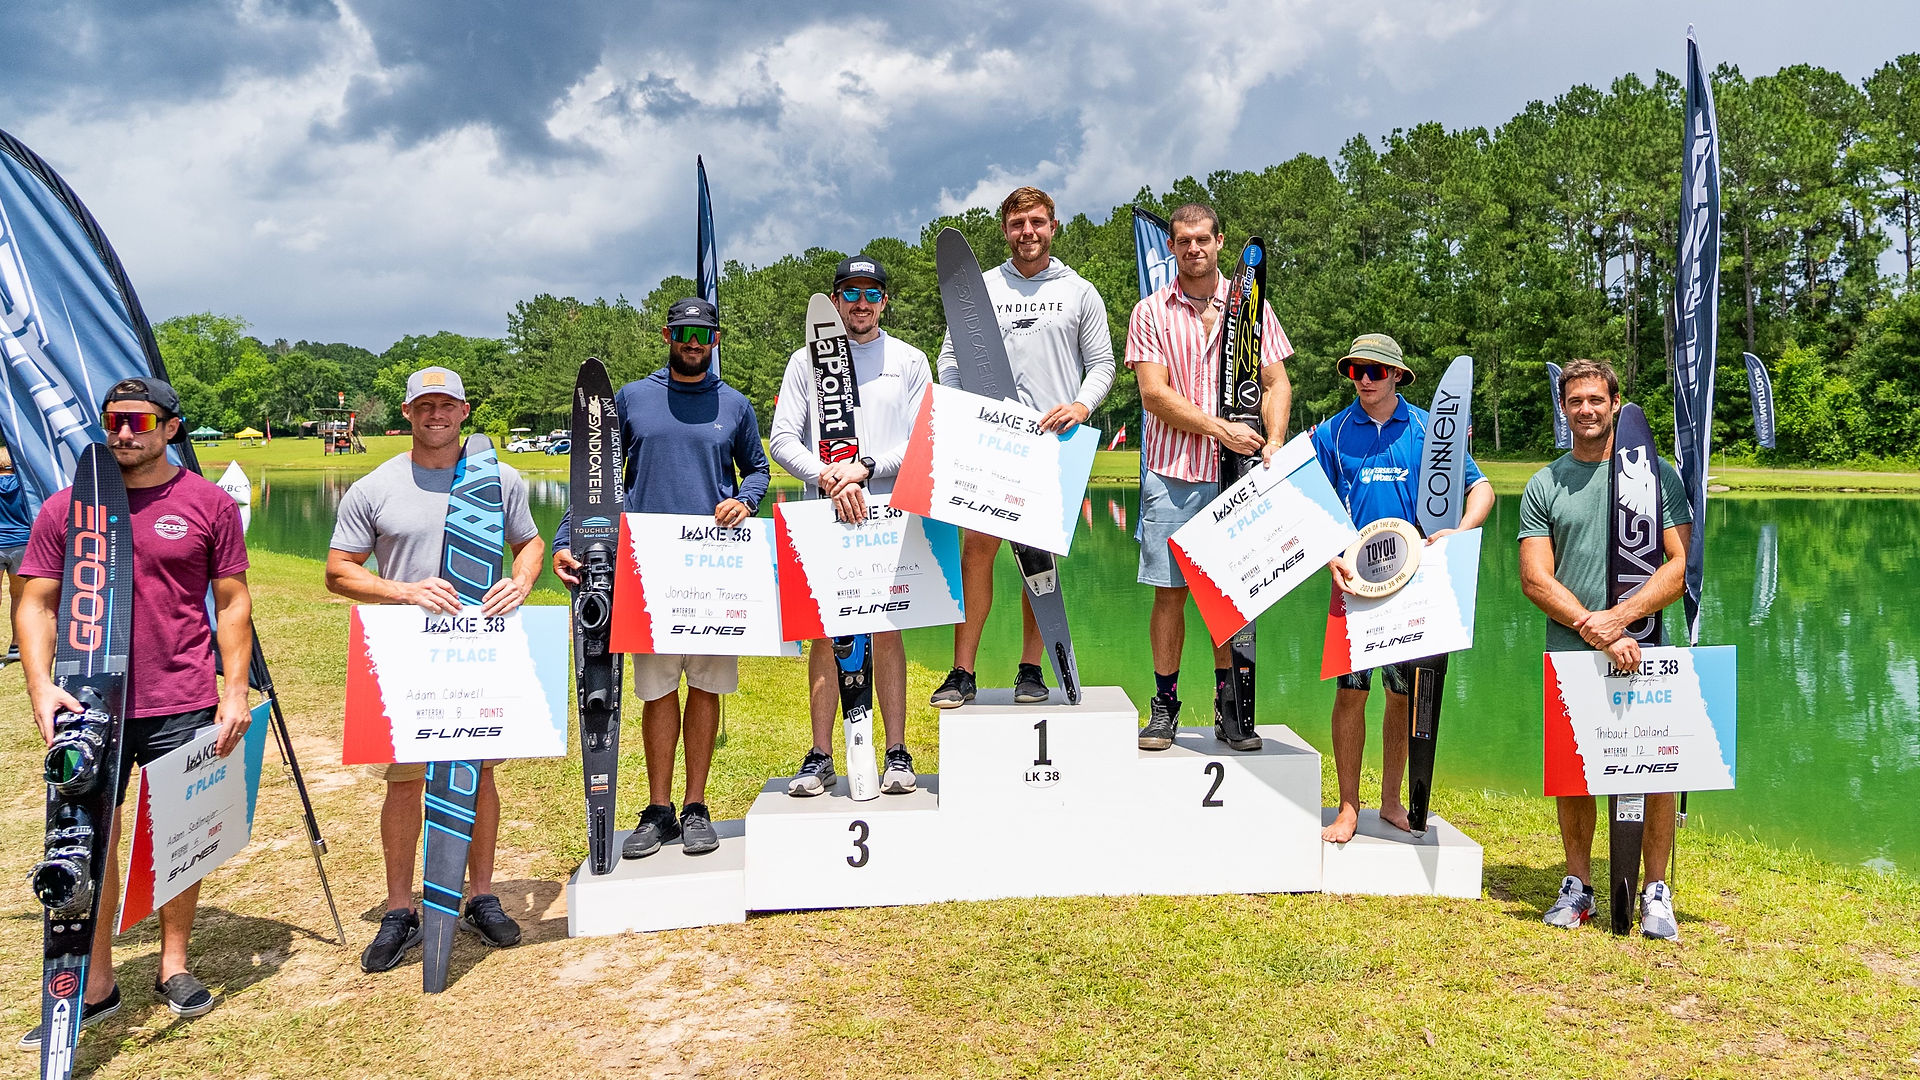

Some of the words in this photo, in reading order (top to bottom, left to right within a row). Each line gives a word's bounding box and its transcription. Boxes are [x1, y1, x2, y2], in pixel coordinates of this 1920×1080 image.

[996, 302, 1063, 314] YNDICATE
[1223, 317, 1237, 407] MasterCraft
[812, 321, 849, 433] LaPoint
[836, 338, 855, 413] JACKTRAVERS.COM
[976, 406, 1024, 431] LAKE
[588, 414, 603, 489] SYNDICATE
[987, 434, 1030, 458] PLACE
[610, 427, 624, 505] JACKTRAVERS.COM
[948, 495, 1022, 522] S-LINES
[1004, 493, 1026, 507] POINTS
[1212, 487, 1249, 525] LAKE
[832, 505, 879, 524] LE
[884, 505, 903, 519] 38
[1237, 497, 1273, 532] PLACE
[678, 525, 728, 541] LAKE
[731, 527, 752, 543] 38
[855, 531, 899, 548] PLACE
[1280, 535, 1300, 554] POINTS
[1365, 537, 1397, 563] TOYOU
[699, 555, 744, 569] PLACE
[68, 500, 107, 652] GOODE
[837, 566, 864, 581] Cole
[1249, 548, 1305, 598] S-LINES
[889, 584, 910, 595] POINTS
[1359, 584, 1374, 593] 2024
[1395, 572, 1407, 584] PRO
[664, 586, 712, 600] Jonathan
[716, 588, 748, 601] Travers
[726, 609, 747, 619] POINTS
[838, 600, 911, 617] S-LINES
[422, 616, 477, 633] LAKE
[483, 616, 505, 633] 38
[670, 624, 747, 636] S-LINES
[1407, 616, 1426, 628] POINTS
[1363, 631, 1425, 653] S-LINES
[446, 648, 497, 663] PLACE
[1658, 659, 1679, 676] 38
[405, 688, 436, 701] Adam
[1627, 689, 1672, 705] PLACE
[479, 707, 504, 719] POINTS
[415, 726, 504, 740] S-LINES
[1033, 719, 1053, 766] 1
[1635, 745, 1645, 755] 12
[1657, 745, 1679, 756] POINTS
[1024, 770, 1041, 782] LK
[1044, 770, 1060, 782] 38
[1602, 762, 1680, 776] S-LINES
[195, 765, 228, 797] PLACE
[1202, 761, 1225, 808] 2
[207, 821, 224, 839] POINTS
[846, 819, 870, 868] 3
[166, 838, 221, 883] S-LINES
